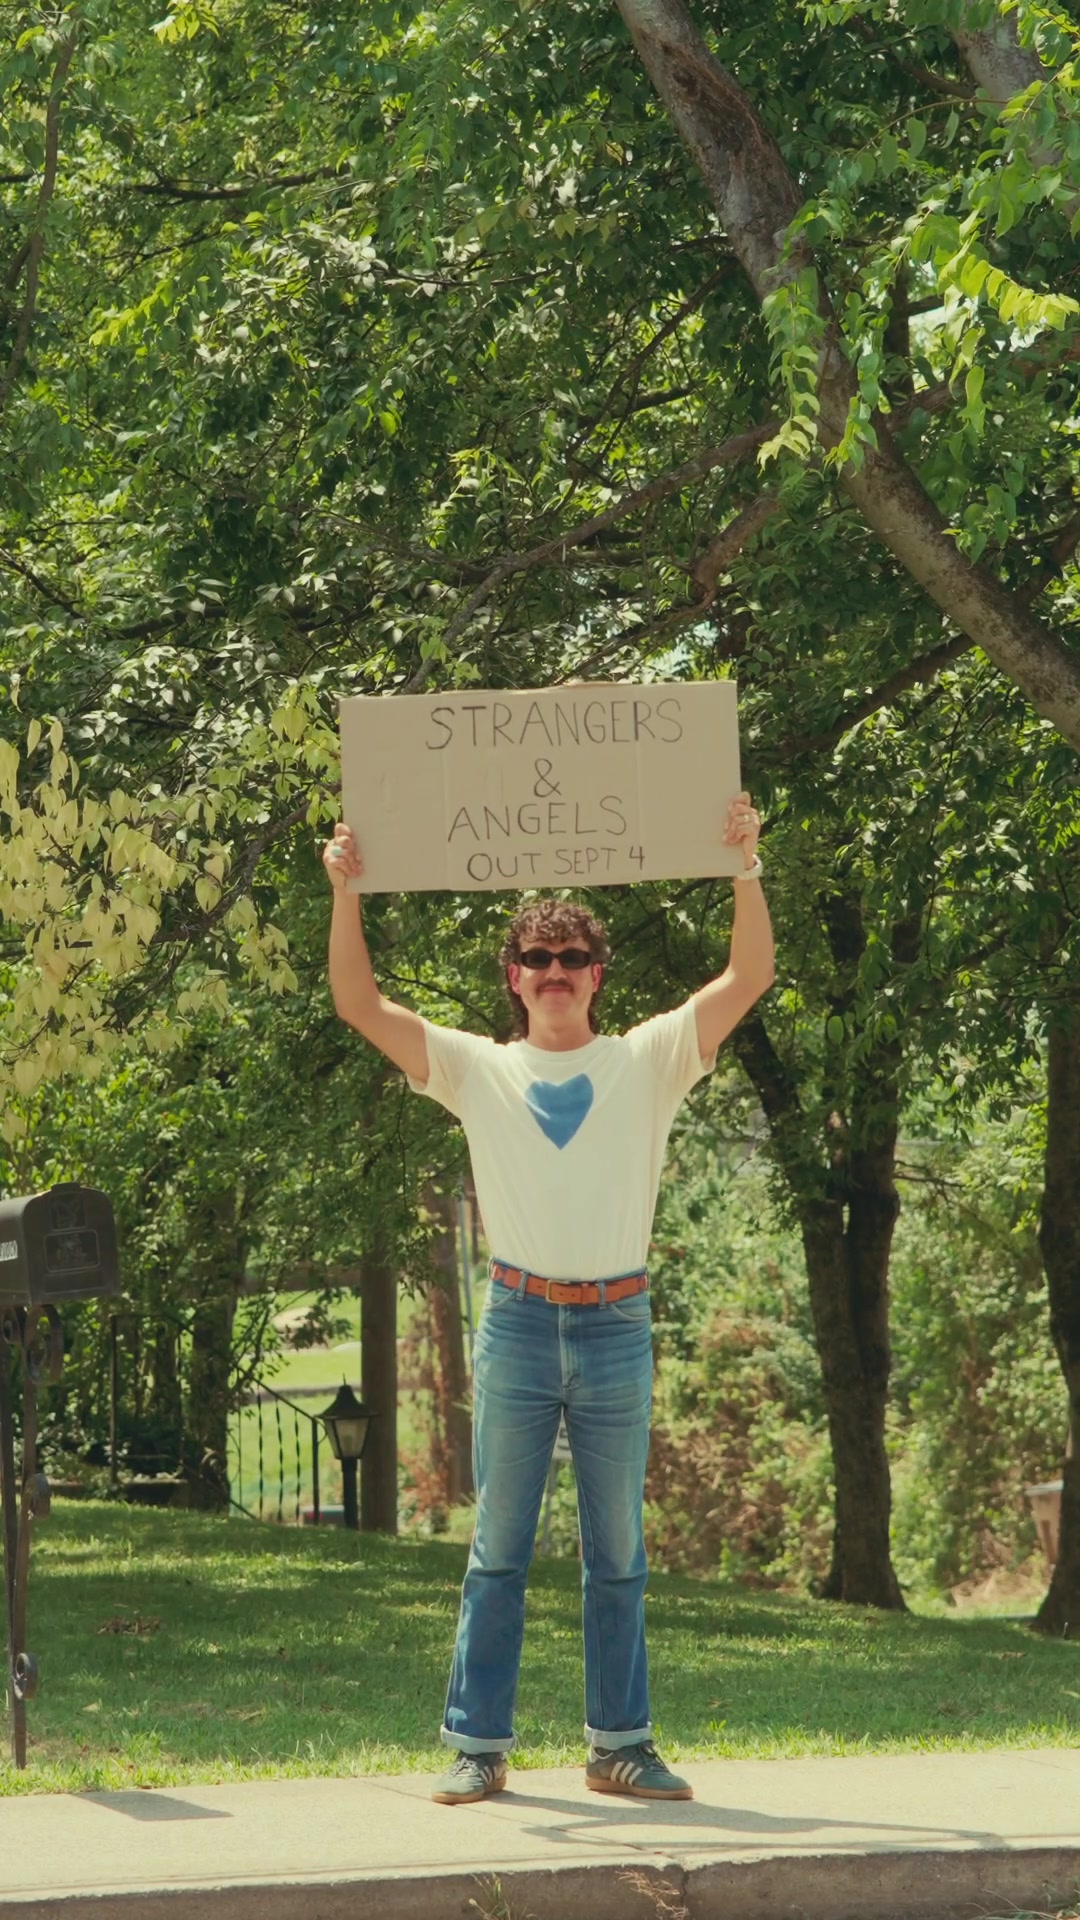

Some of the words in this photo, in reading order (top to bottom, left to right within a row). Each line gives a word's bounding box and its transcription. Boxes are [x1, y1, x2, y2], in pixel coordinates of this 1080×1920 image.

[425, 698, 683, 750] STRANGERS
[533, 758, 561, 798] &
[448, 795, 627, 842] ANGELS
[467, 852, 541, 881] OUT
[554, 847, 616, 875] SEPT
[629, 846, 646, 870] 4
